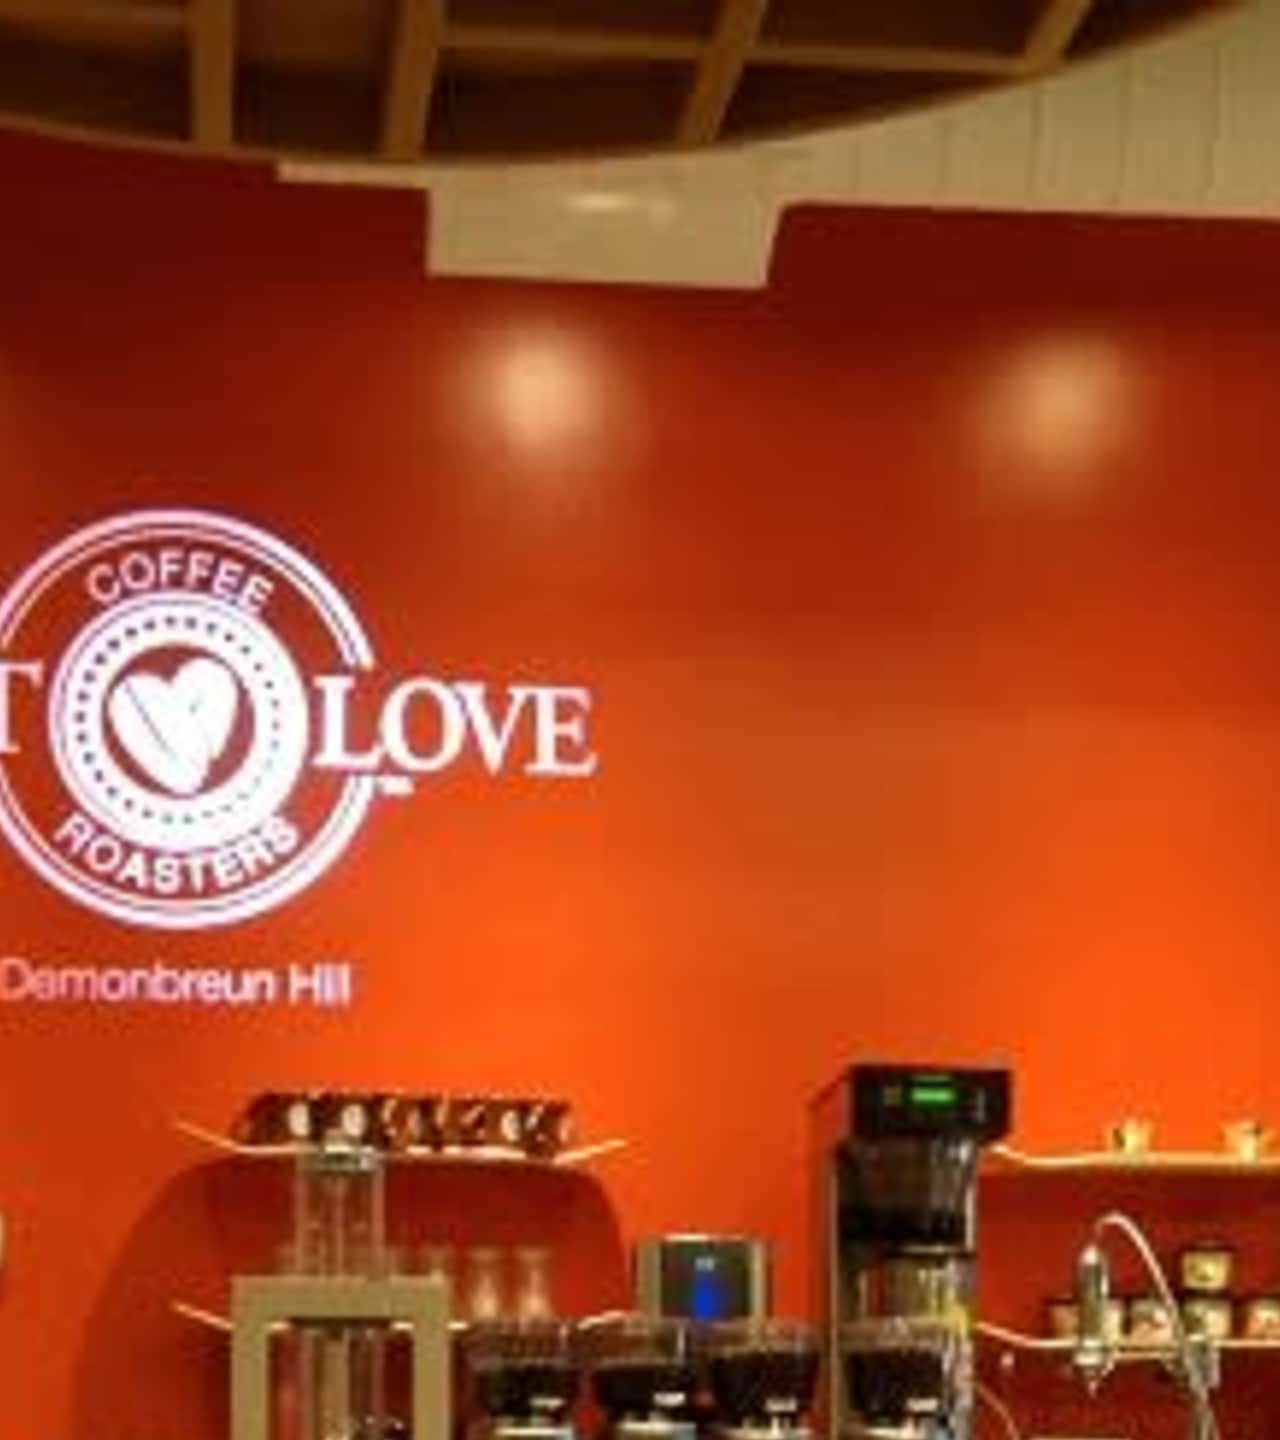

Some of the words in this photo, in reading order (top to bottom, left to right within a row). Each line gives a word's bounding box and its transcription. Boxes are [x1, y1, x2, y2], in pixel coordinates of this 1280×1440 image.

[87, 550, 274, 615] COFFEE
[312, 675, 597, 776] LOVE
[54, 812, 298, 893] ROASTERS
[289, 962, 352, 1005] Hill
